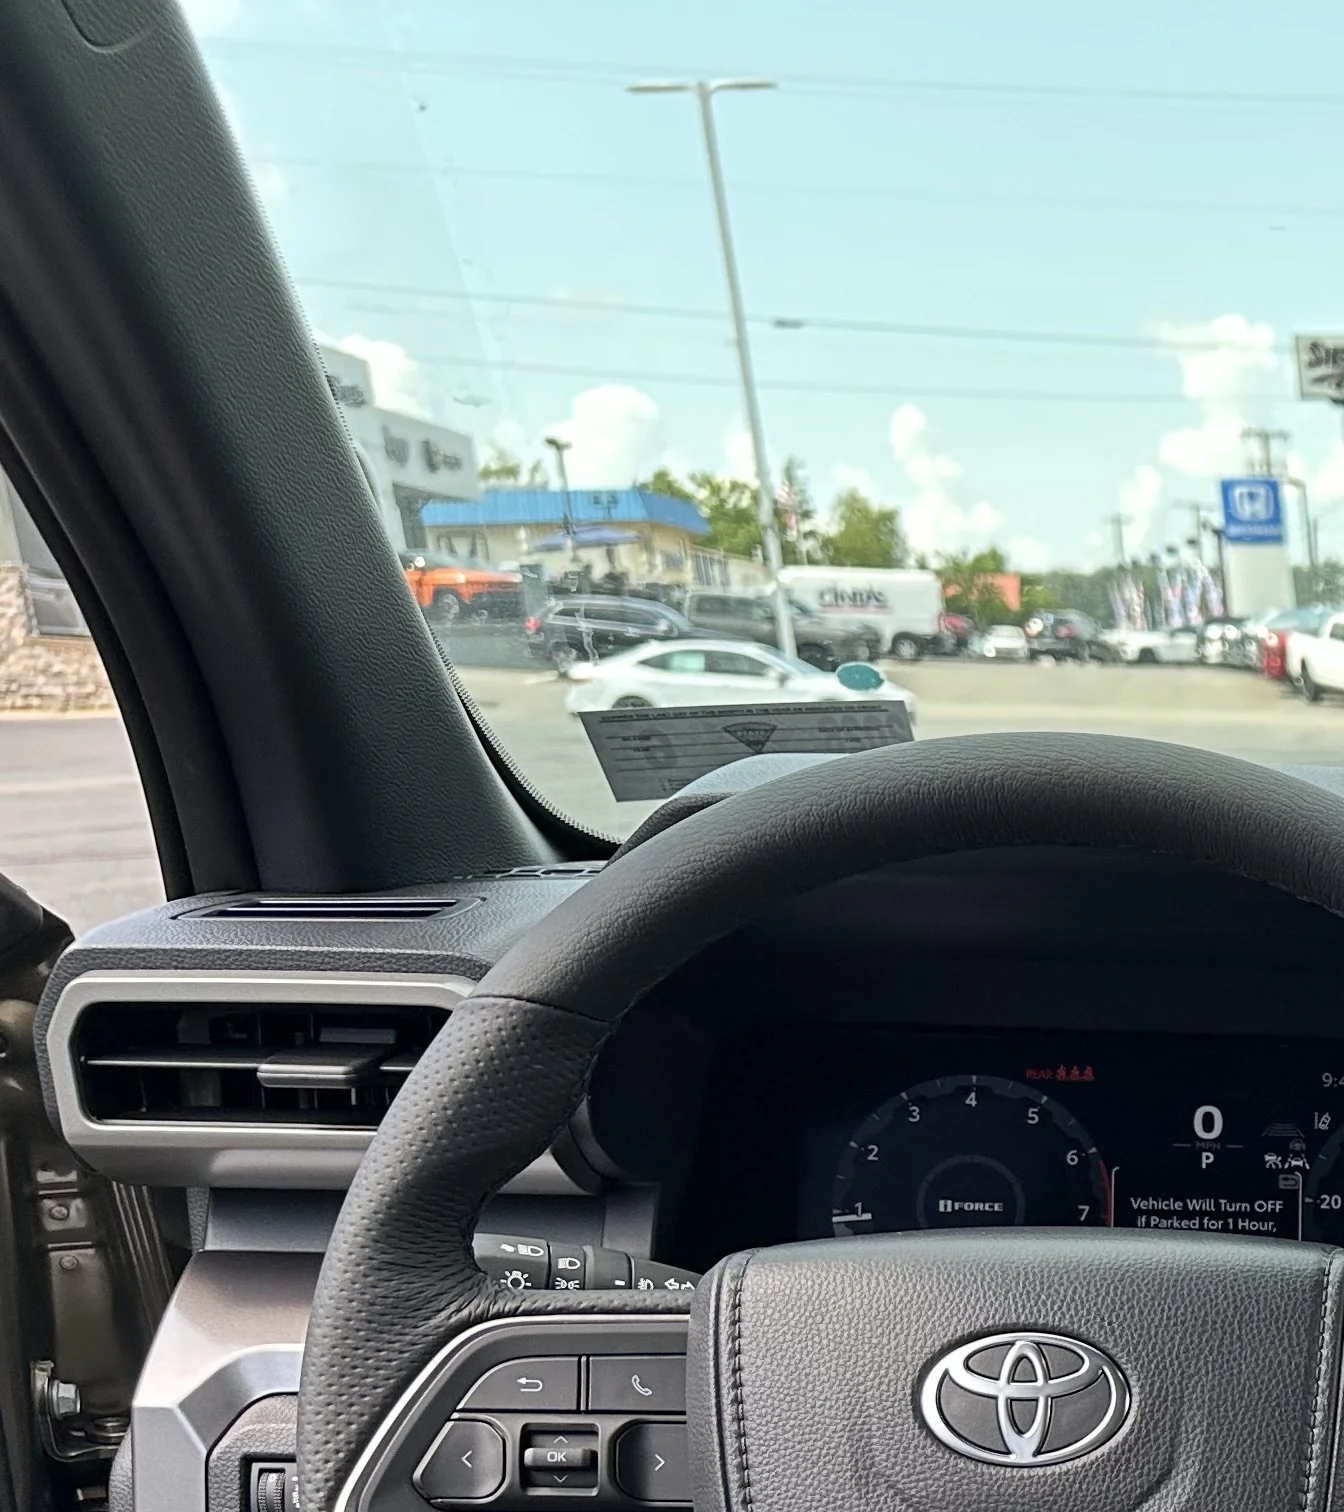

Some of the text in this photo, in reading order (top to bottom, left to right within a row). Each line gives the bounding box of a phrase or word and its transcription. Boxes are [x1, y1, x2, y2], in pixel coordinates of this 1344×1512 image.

[1025, 1068, 1053, 1081] REAR
[965, 1092, 978, 1107] 4
[908, 1106, 921, 1122] 3
[1027, 1108, 1040, 1124] 5
[1192, 1105, 1224, 1140] 0
[867, 1145, 879, 1161] 2
[1196, 1141, 1221, 1151] MPH
[1066, 1150, 1079, 1166] 6
[1201, 1152, 1215, 1169] P
[854, 1202, 863, 1217] 1
[1130, 1197, 1284, 1213] Vehicle Will Turn OFF
[1320, 1195, 1342, 1210] 20
[1078, 1205, 1090, 1222] 7
[1150, 1216, 1200, 1230] Parked
[1203, 1216, 1224, 1230] for
[1238, 1218, 1277, 1232] Hour,
[547, 1451, 567, 1463] OK
